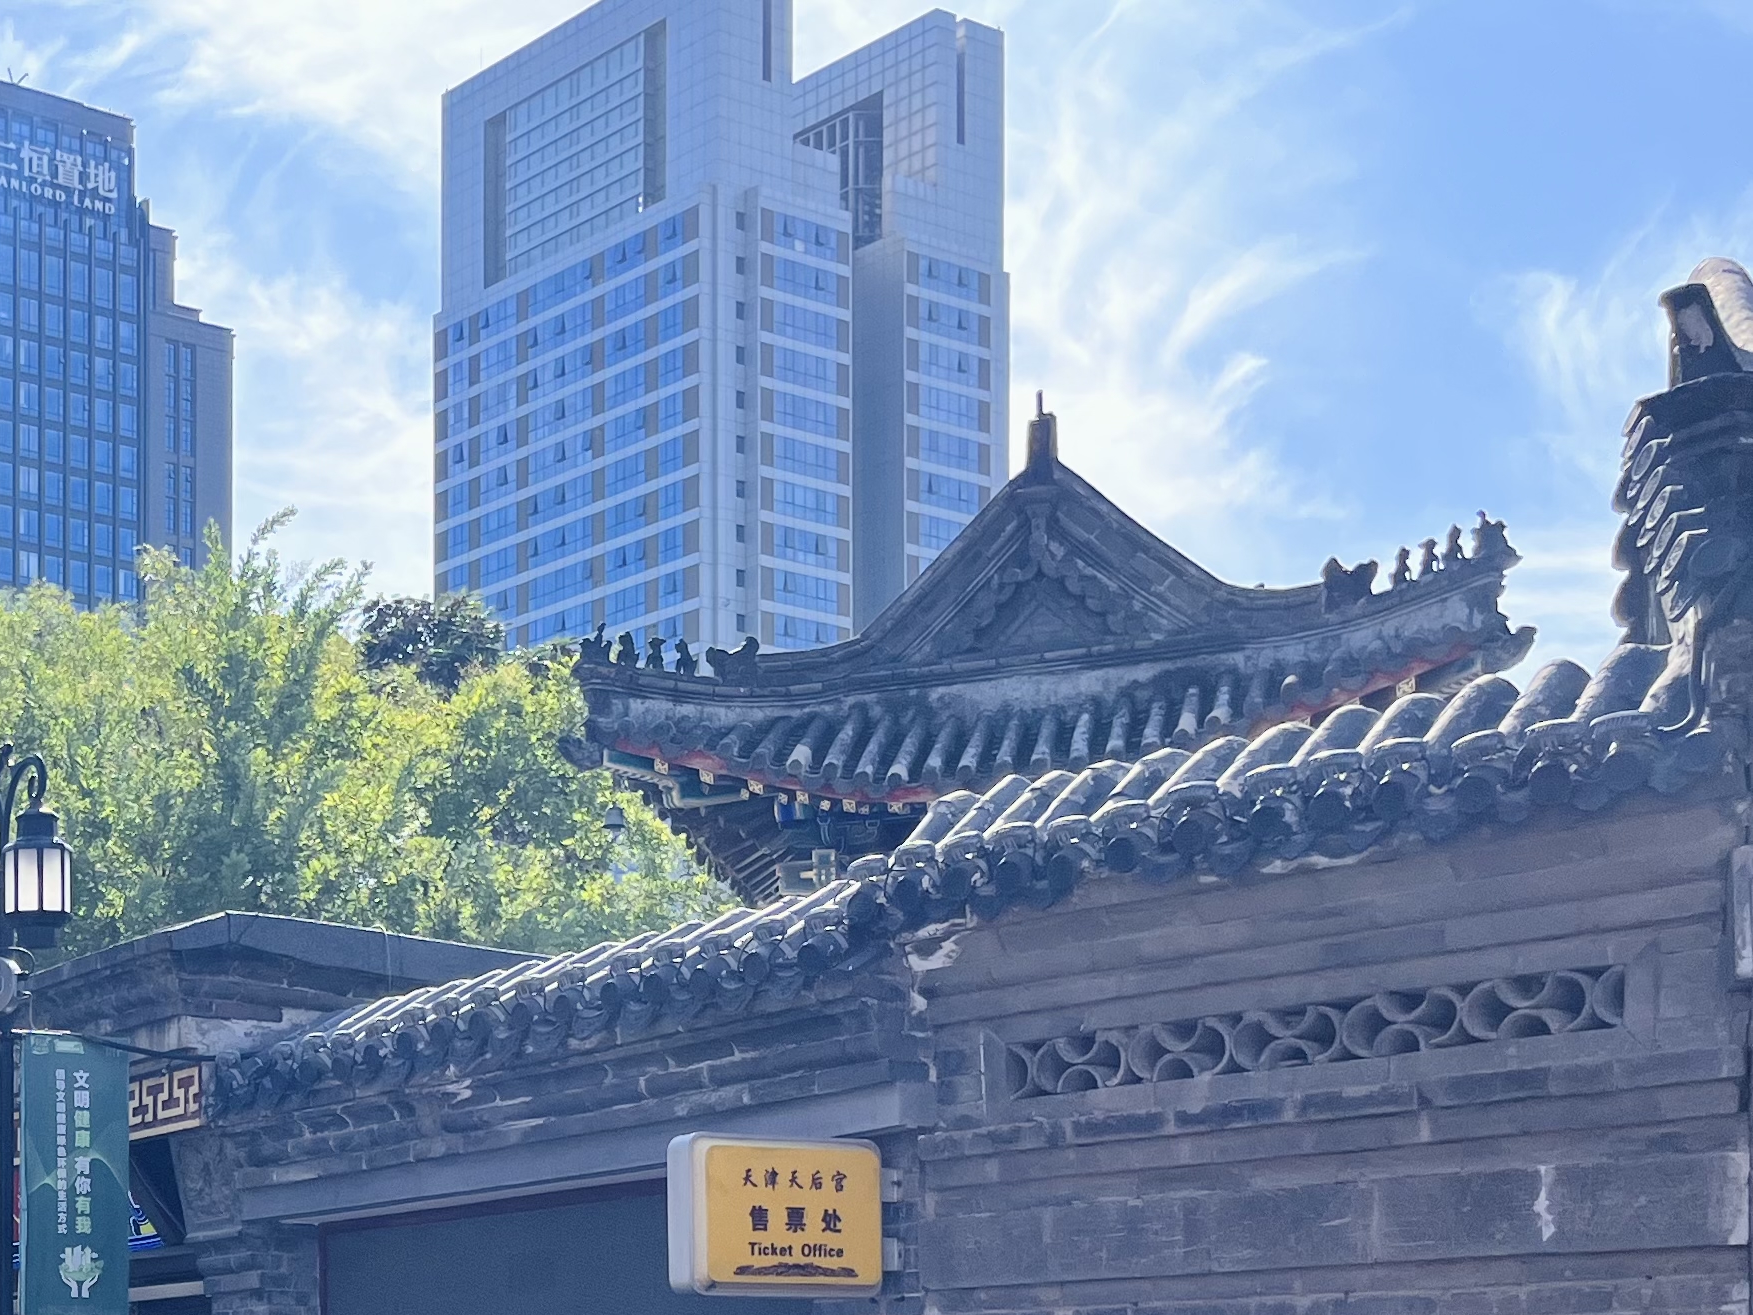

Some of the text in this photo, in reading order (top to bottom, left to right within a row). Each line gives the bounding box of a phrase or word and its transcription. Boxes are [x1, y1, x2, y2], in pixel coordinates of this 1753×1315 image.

[73, 190, 116, 215] LAND
[73, 1070, 92, 1235] 文明健康 有你有我
[742, 1167, 848, 1193] 天津天后宫
[749, 1205, 843, 1233] 售票处
[748, 1241, 844, 1258] Ticket Office
